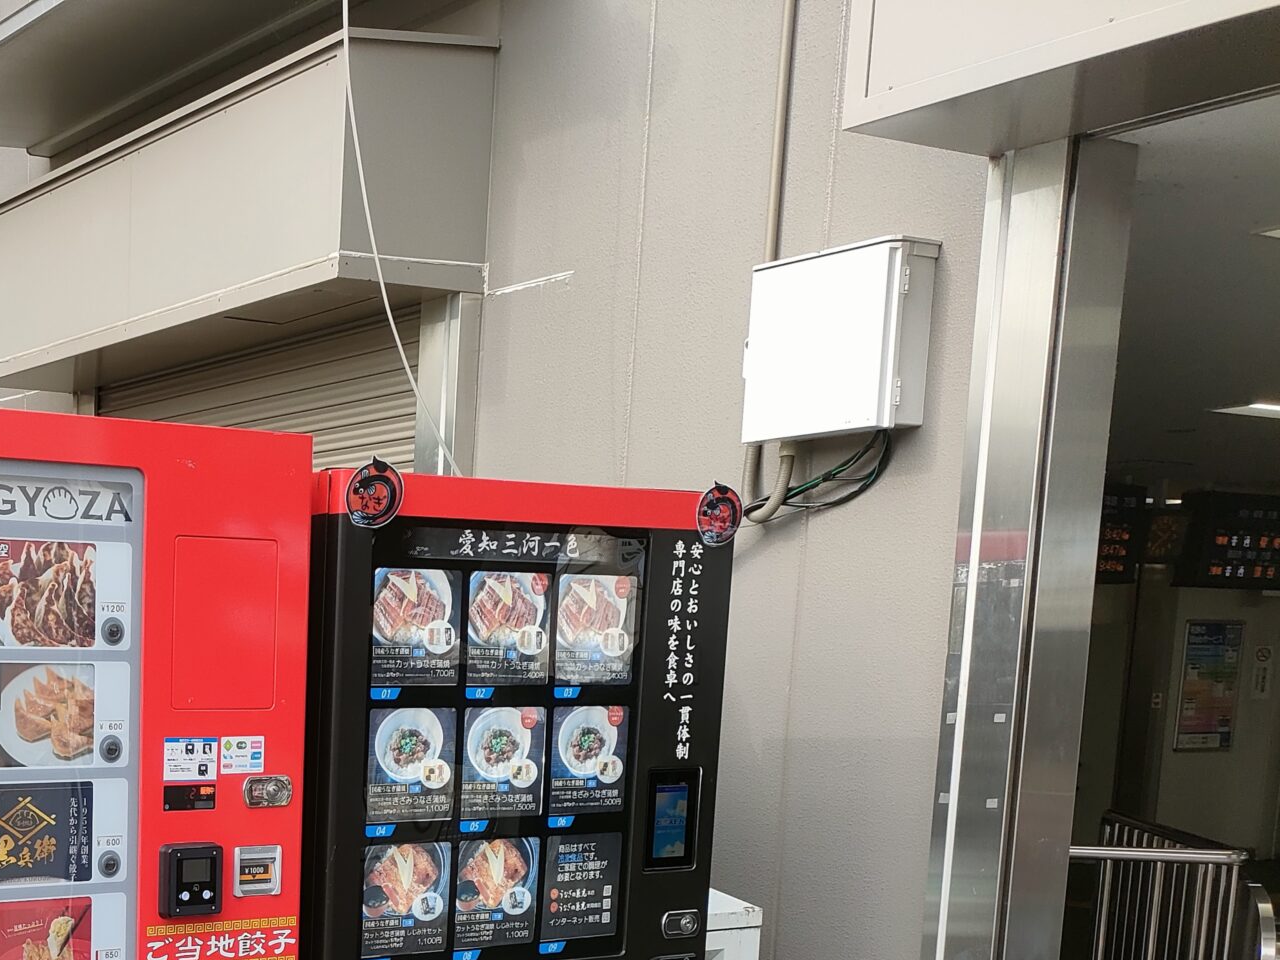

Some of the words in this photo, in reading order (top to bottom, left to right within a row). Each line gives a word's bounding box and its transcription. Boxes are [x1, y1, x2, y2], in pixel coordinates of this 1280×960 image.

[458, 529, 580, 557] 愛知三河一色
[663, 539, 687, 702] 専門店の味を食卓へ
[675, 542, 704, 760] 安心とおいしさの一貫体制
[381, 689, 391, 698] 01
[475, 688, 485, 698] 02
[563, 688, 573, 697] 03
[375, 826, 386, 836] 04
